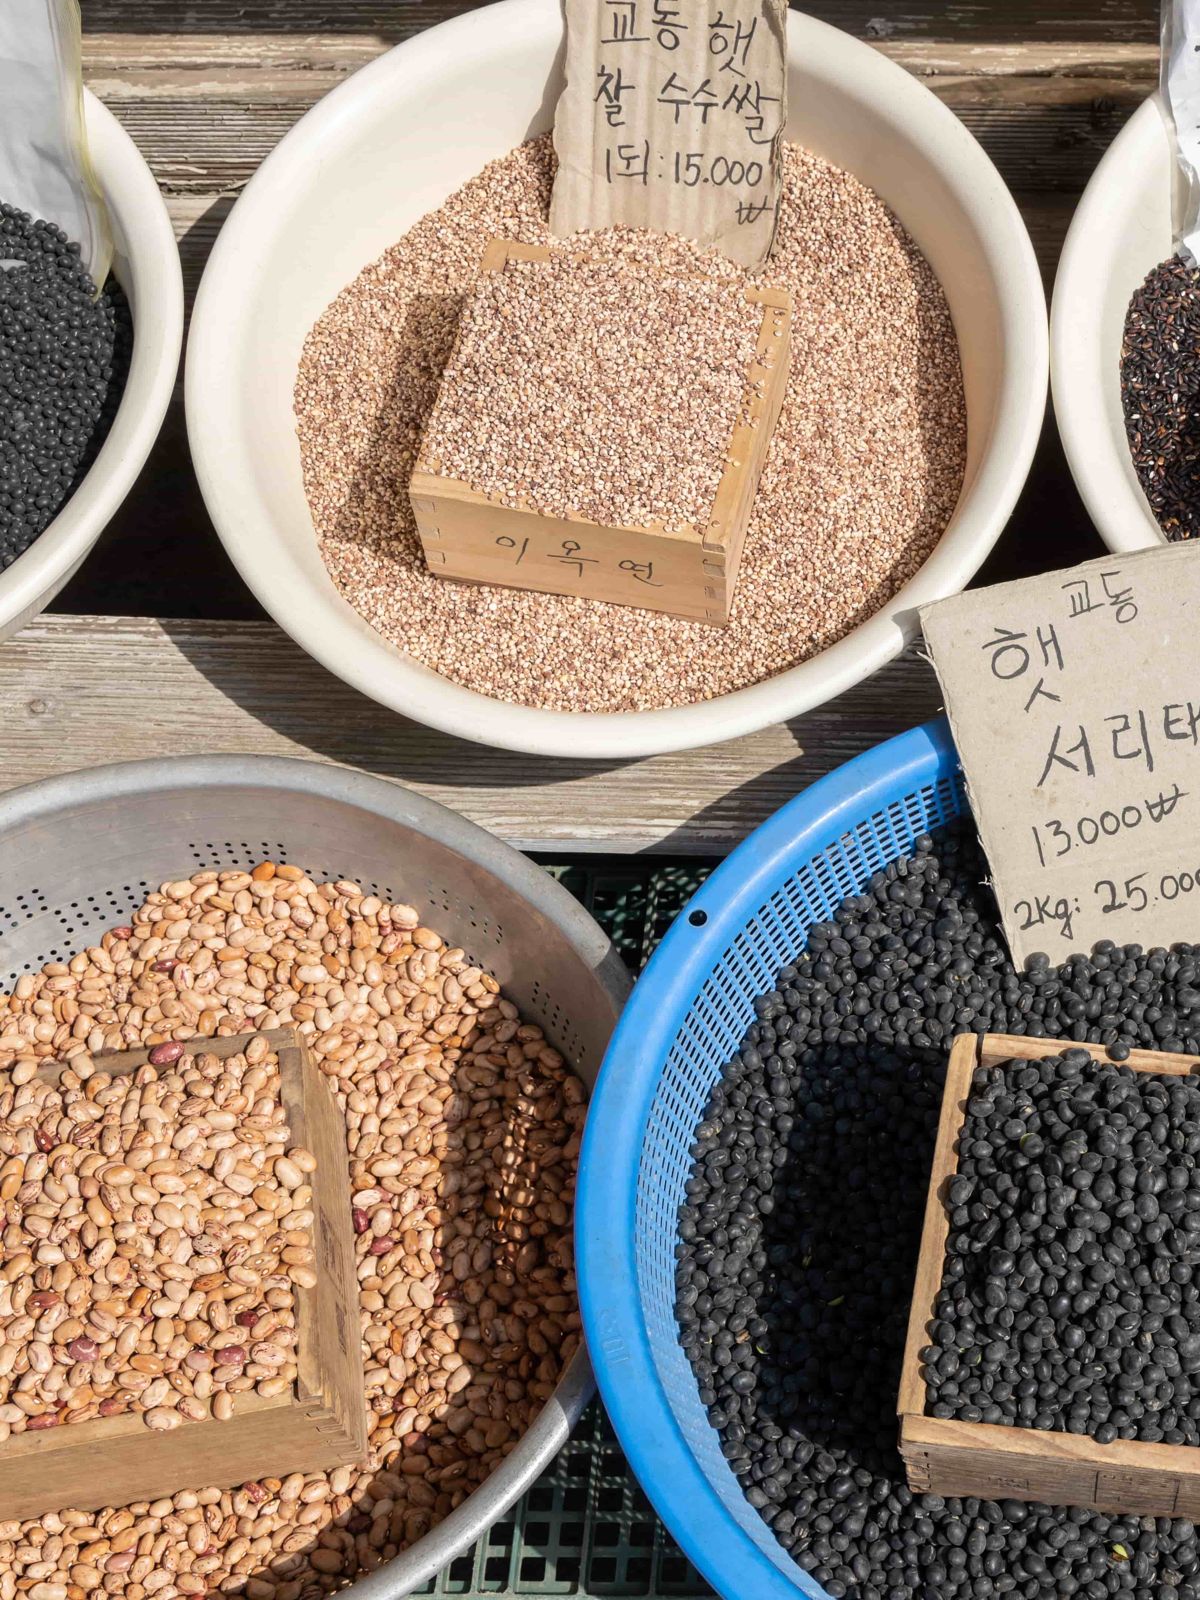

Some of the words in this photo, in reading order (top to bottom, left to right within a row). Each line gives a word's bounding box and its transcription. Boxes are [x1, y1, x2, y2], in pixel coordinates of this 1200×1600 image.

[593, 64, 636, 128] 찰
[1061, 571, 1139, 624] 교동
[981, 623, 1065, 713] 햇
